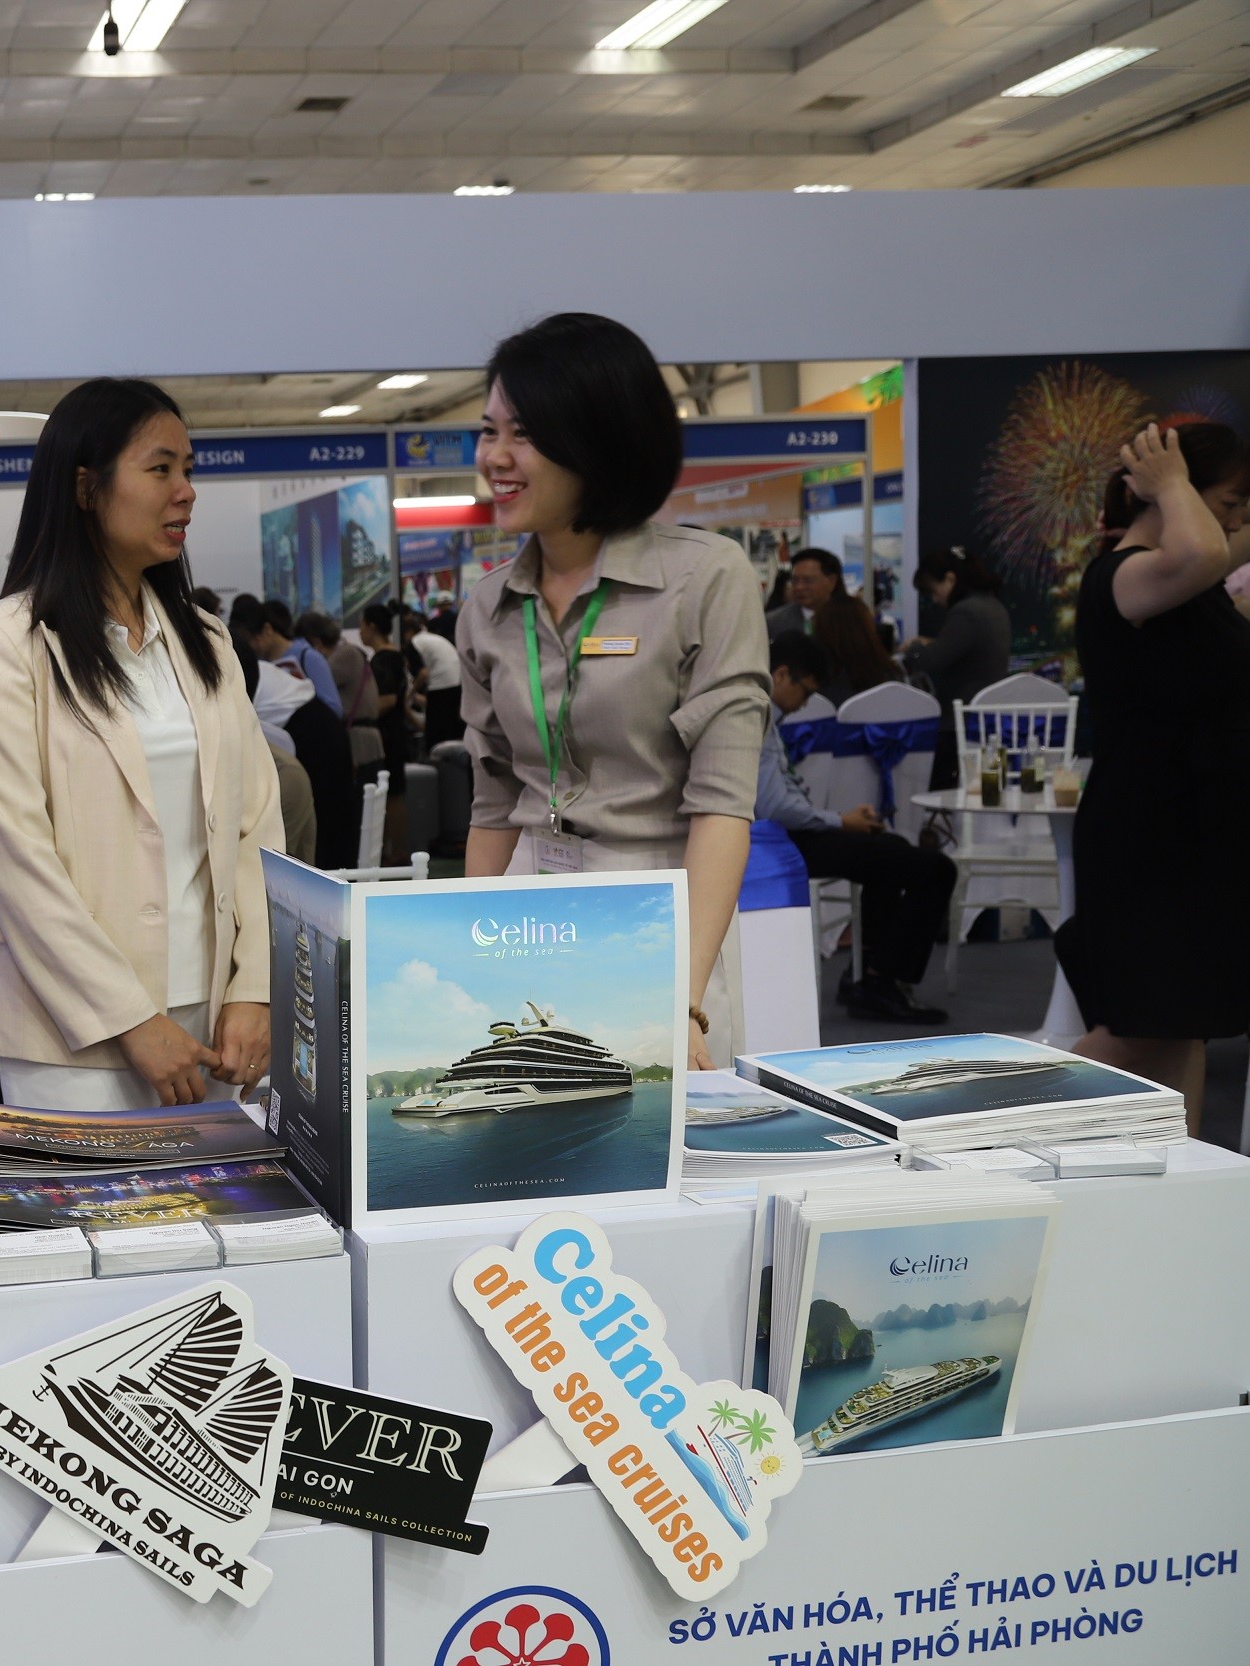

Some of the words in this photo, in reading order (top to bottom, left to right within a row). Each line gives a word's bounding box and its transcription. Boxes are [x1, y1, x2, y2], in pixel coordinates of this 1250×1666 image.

[787, 431, 839, 446] A2-230
[309, 447, 365, 462] A2-229
[471, 916, 577, 948] Celina
[494, 948, 506, 959] of
[510, 947, 530, 957] the
[534, 947, 554, 956] sea
[341, 1000, 349, 1032] CELINA
[341, 1033, 349, 1045] OF
[341, 1046, 349, 1064] THE
[341, 1066, 349, 1082] SEA
[783, 1080, 800, 1093] CELINA
[821, 1097, 838, 1110] CRUISE
[15, 1133, 117, 1149] MEKONG
[474, 1177, 566, 1189] CELINAOFTHESEA.COM
[69, 1208, 213, 1220] REVER
[889, 1252, 970, 1278] Celina
[904, 1275, 914, 1285] of
[917, 1274, 931, 1283] the
[933, 1273, 948, 1282] sea
[533, 1227, 688, 1430] Celina
[291, 1391, 464, 1483] EVER
[472, 1263, 510, 1310] of
[503, 1299, 568, 1373] the
[553, 1368, 621, 1448] sea
[608, 1442, 725, 1585] cruises
[14, 1465, 135, 1551] INDOCHINA
[133, 1541, 196, 1588] SAILS
[280, 1491, 295, 1501] OF
[298, 1495, 361, 1517] INDOCHINA
[365, 1509, 399, 1526] SAILS
[401, 1517, 473, 1543] COLLECTION
[141, 1506, 247, 1591] SAGA
[668, 1608, 720, 1645] SỞ
[724, 1602, 796, 1642] VĂN
[801, 1586, 884, 1632] HÓA,
[893, 1568, 961, 1614] THỂ
[965, 1570, 1057, 1607] THAO
[1063, 1555, 1114, 1595] VÀ
[1117, 1557, 1160, 1589] DU
[1164, 1548, 1240, 1588] LỊCH
[768, 1636, 886, 1666] THÀNH
[891, 1620, 962, 1661] PHỐ
[966, 1614, 1024, 1655] HẢI
[1031, 1604, 1145, 1649] PHÒNG
